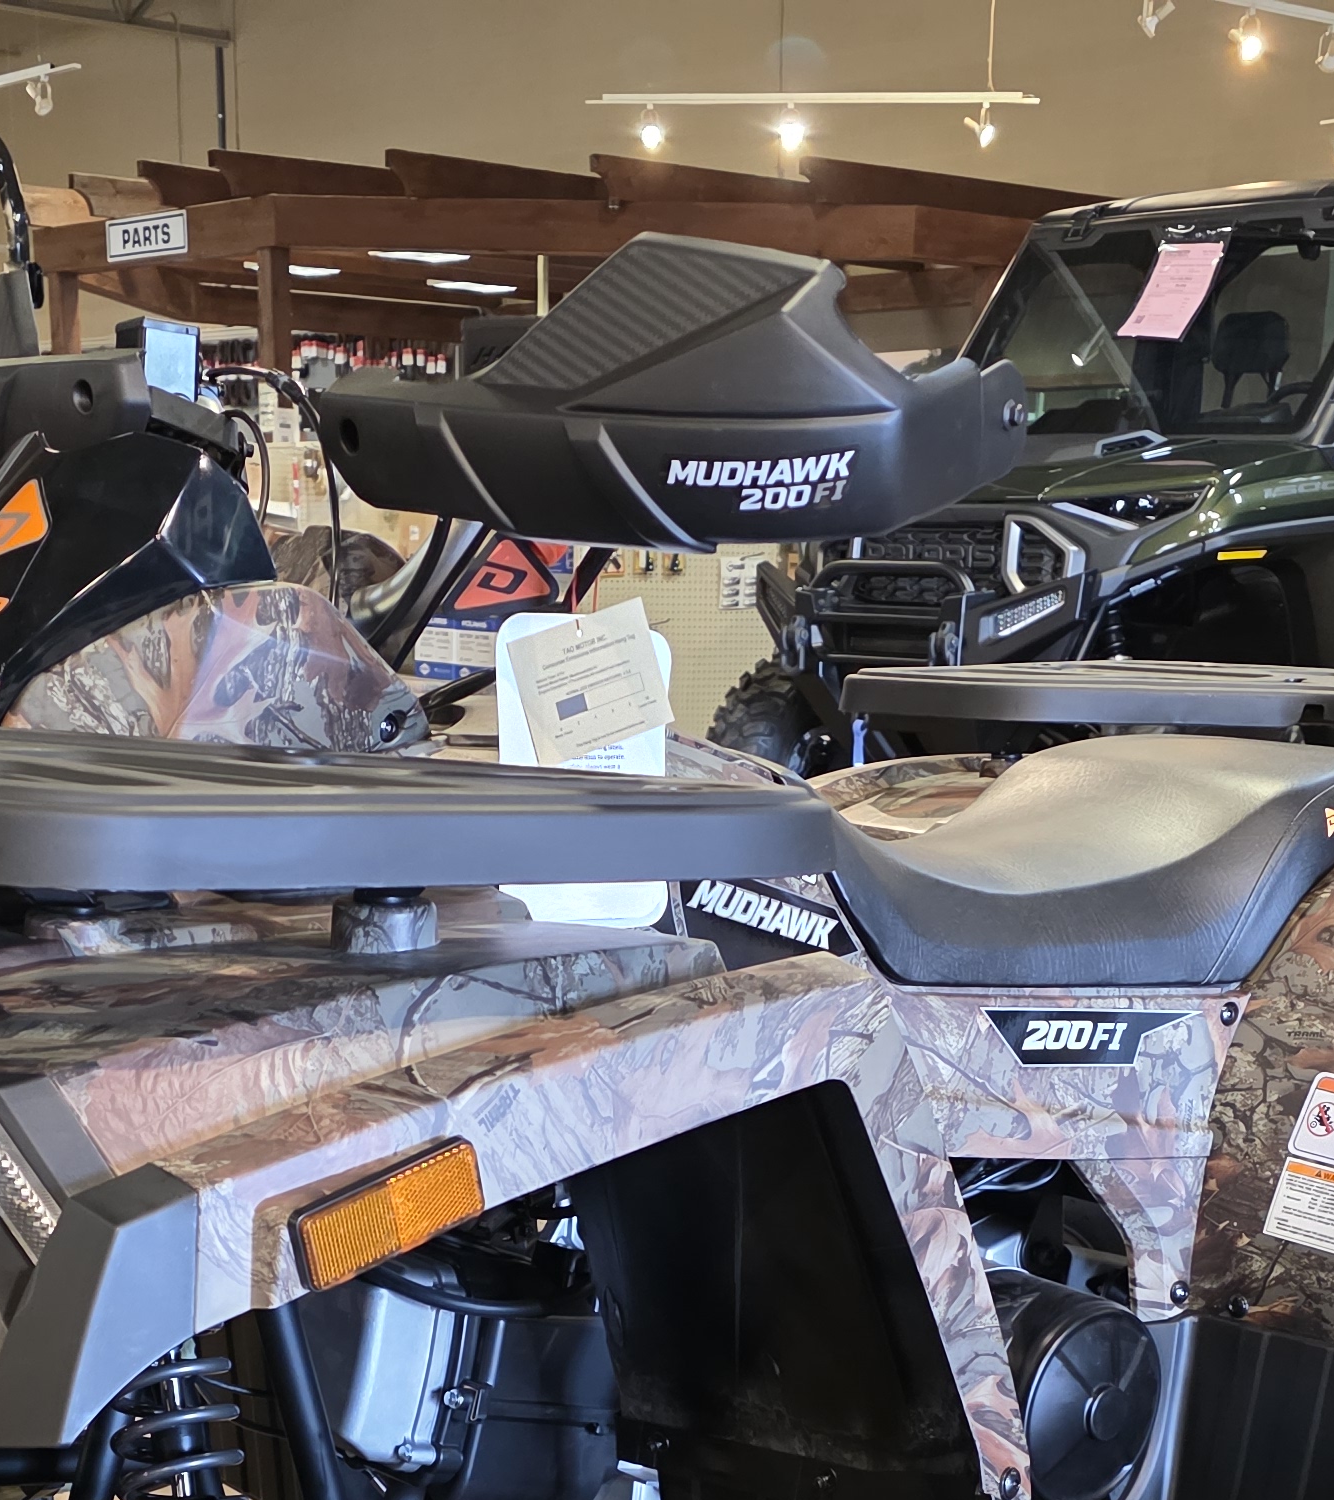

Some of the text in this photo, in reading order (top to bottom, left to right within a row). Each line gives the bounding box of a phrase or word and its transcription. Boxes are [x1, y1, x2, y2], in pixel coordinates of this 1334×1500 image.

[122, 223, 171, 250] PARTS
[666, 449, 856, 487] MUDHAWK
[685, 878, 840, 951] MUDHAWK
